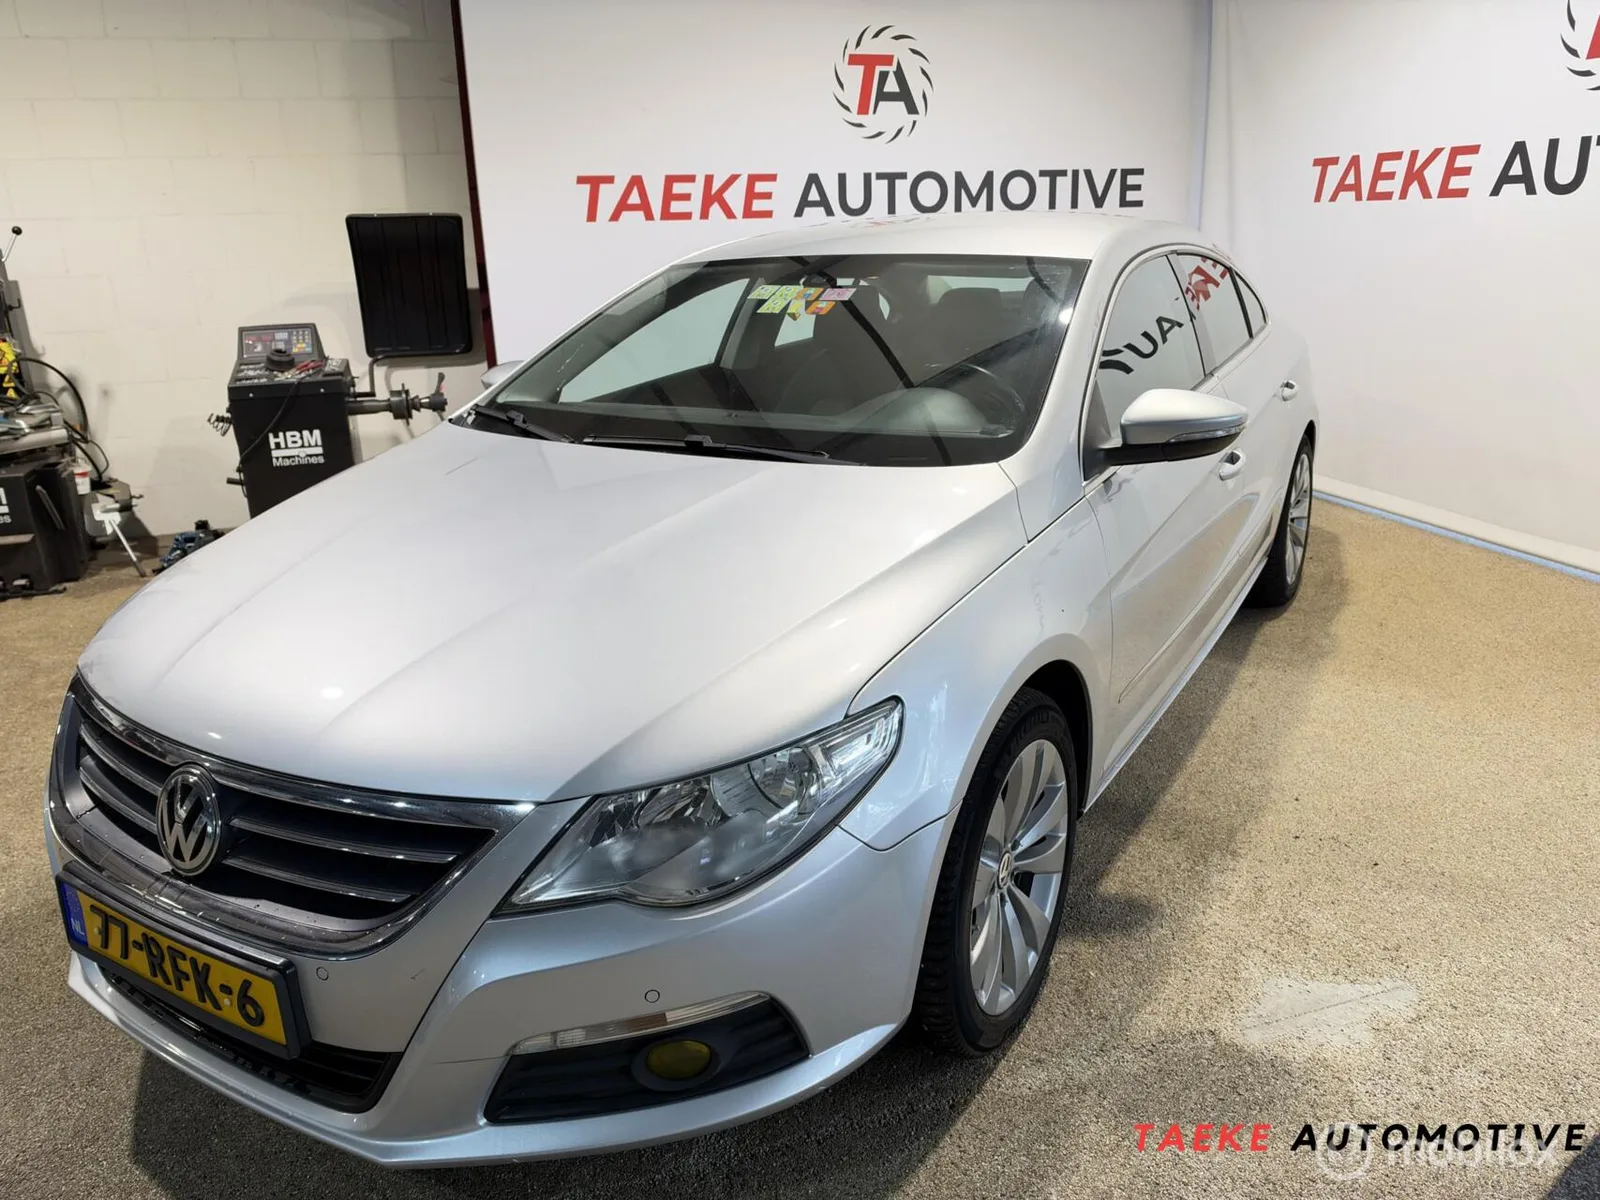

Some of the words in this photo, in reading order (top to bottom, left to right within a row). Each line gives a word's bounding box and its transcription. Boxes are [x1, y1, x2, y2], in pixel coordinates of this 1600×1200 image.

[847, 54, 920, 116] TA
[576, 173, 778, 223] TAEKE
[794, 168, 1145, 218] AUTOMOTIVE
[1312, 144, 1482, 203] TAEKE
[1489, 135, 1600, 197] AU
[268, 429, 323, 450] HBM
[272, 455, 325, 467] Machines
[89, 904, 265, 1027] 77-RFK-6
